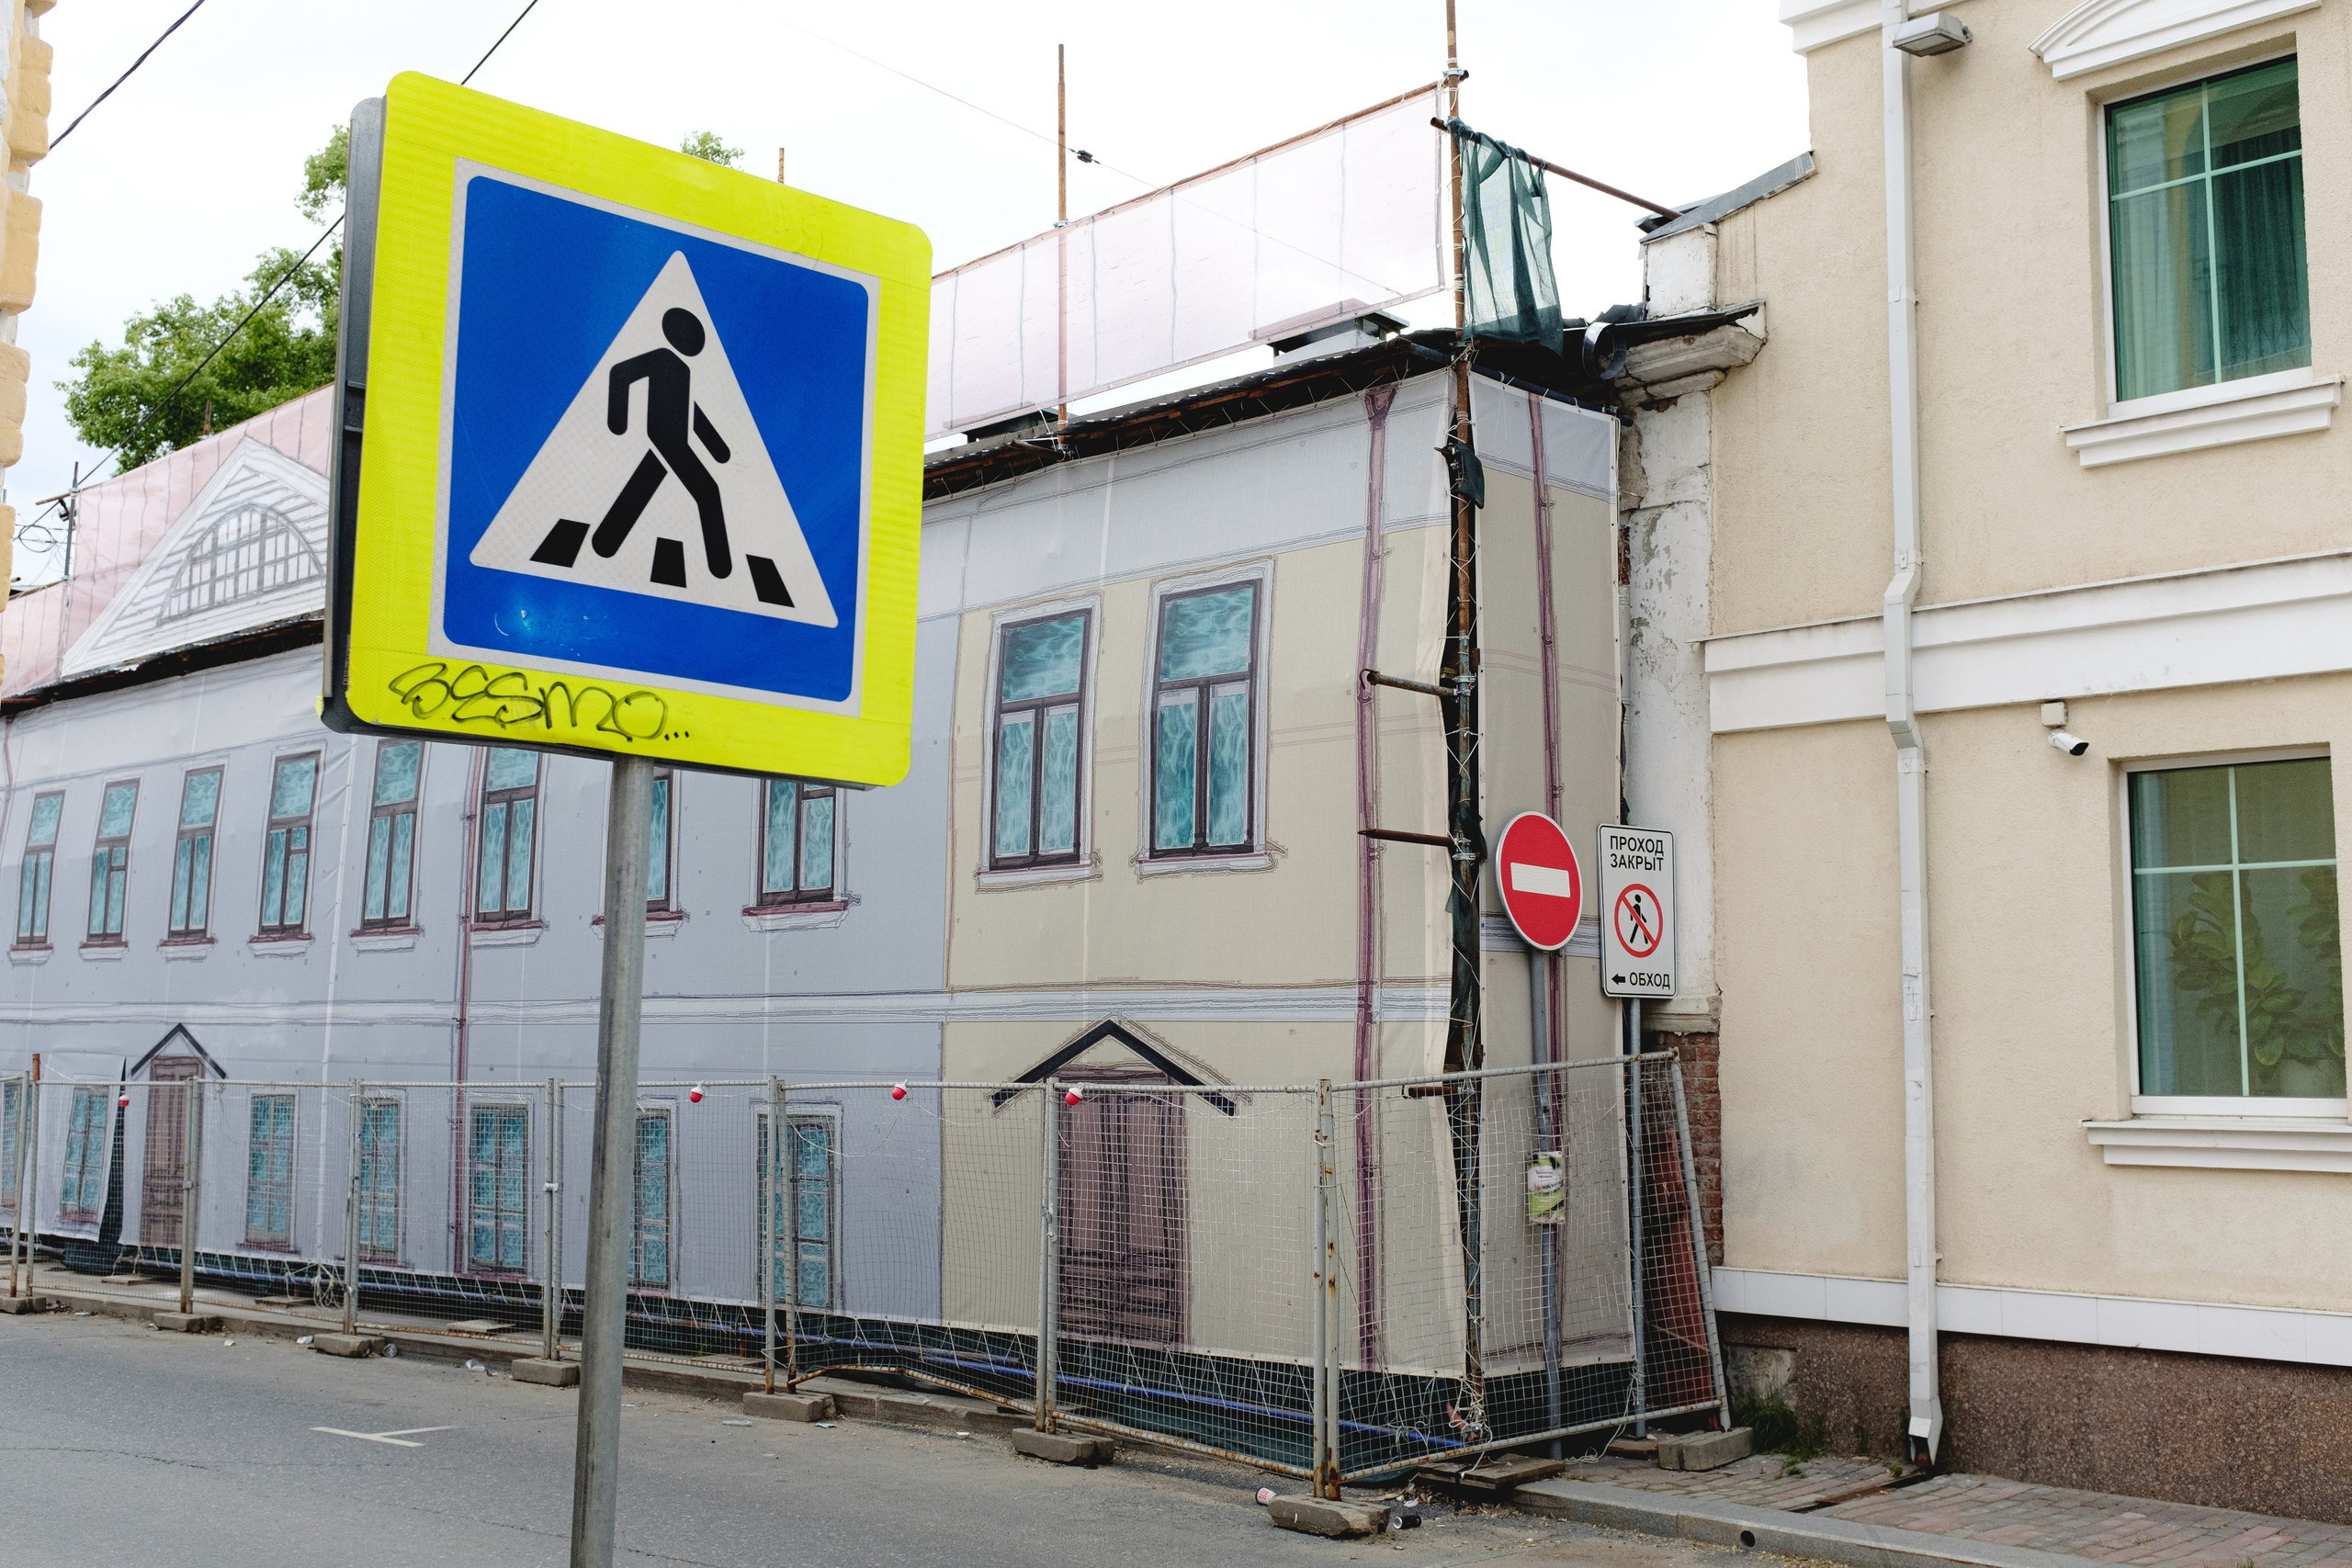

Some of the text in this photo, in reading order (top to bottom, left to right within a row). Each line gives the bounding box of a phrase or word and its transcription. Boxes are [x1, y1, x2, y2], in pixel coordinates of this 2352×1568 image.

[1610, 835, 1664, 856] ПРОХОД
[1610, 853, 1664, 872] ЗАКРЫТ
[1629, 972, 1670, 989] ОБХОД
